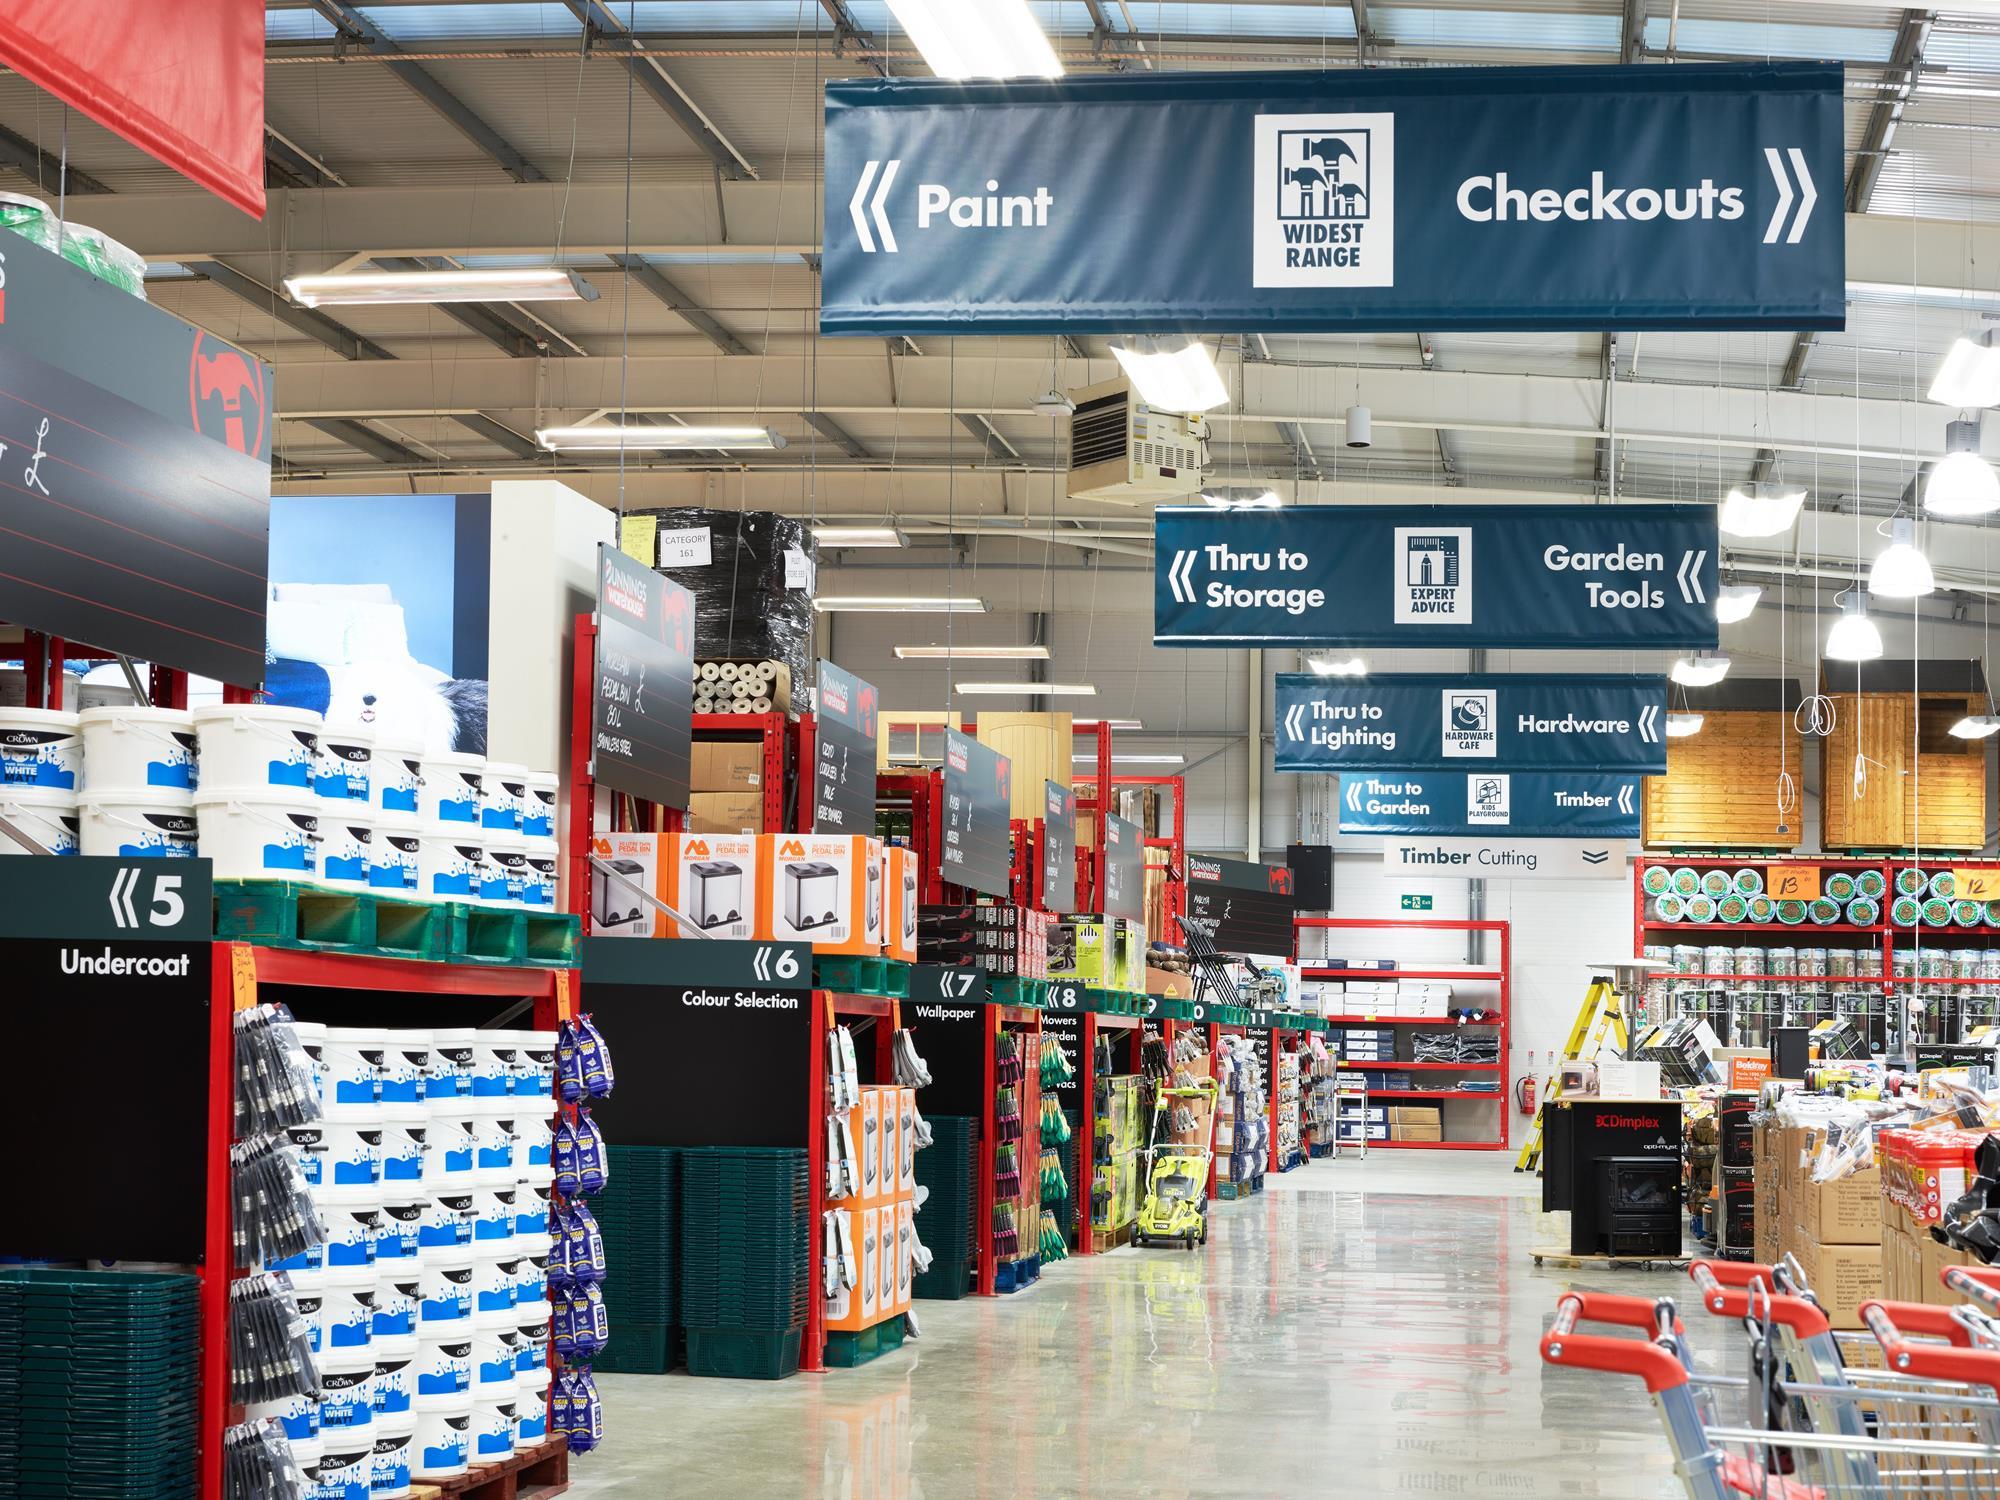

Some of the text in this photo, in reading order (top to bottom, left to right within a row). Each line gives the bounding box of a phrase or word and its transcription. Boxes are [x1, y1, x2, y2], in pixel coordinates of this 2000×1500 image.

[1455, 171, 1745, 222] Checkouts
[917, 181, 1054, 229] Paint
[1283, 223, 1364, 245] WIDEST
[1285, 247, 1361, 268] RANGE
[665, 534, 707, 545] CATEGORY
[679, 549, 694, 558] 161
[1205, 545, 1308, 571] Thru to
[1543, 544, 1664, 571] Garden
[1206, 581, 1325, 615] Storage
[1410, 587, 1456, 600] EXPERT
[1585, 581, 1665, 609] Tools
[1410, 600, 1455, 614] ADVICE
[1310, 700, 1383, 720] Thru to
[1518, 714, 1630, 734] Hardware
[6, 732, 38, 743] CROWN
[1311, 726, 1396, 751] Lighting
[1445, 732, 1494, 741] HARDWARE
[1458, 741, 1480, 750] CAFE
[4, 766, 38, 776] WHITE
[4, 774, 36, 782] MATT
[1366, 780, 1423, 796] Thru to
[1366, 800, 1431, 816] Garden
[1554, 792, 1612, 808] Timber
[1190, 858, 1221, 874] BUNNINGS
[1400, 847, 1538, 870] Timber Cutting
[1779, 876, 1799, 895] 13
[1966, 879, 1989, 895] 12
[150, 875, 185, 927] 5
[60, 946, 190, 977] Undercoat
[775, 950, 799, 979] 6
[958, 974, 976, 996] 7
[682, 990, 798, 1010] Colour Selection
[1062, 988, 1077, 1008] 8
[916, 1005, 976, 1022] Wallpaper
[1250, 1012, 1266, 1024] 11
[1736, 1061, 1768, 1072] Beldray
[1608, 1116, 1660, 1130] Dimplex
[326, 1377, 354, 1386] CROWN
[324, 1409, 353, 1418] WHITE
[324, 1416, 352, 1424] MATT
